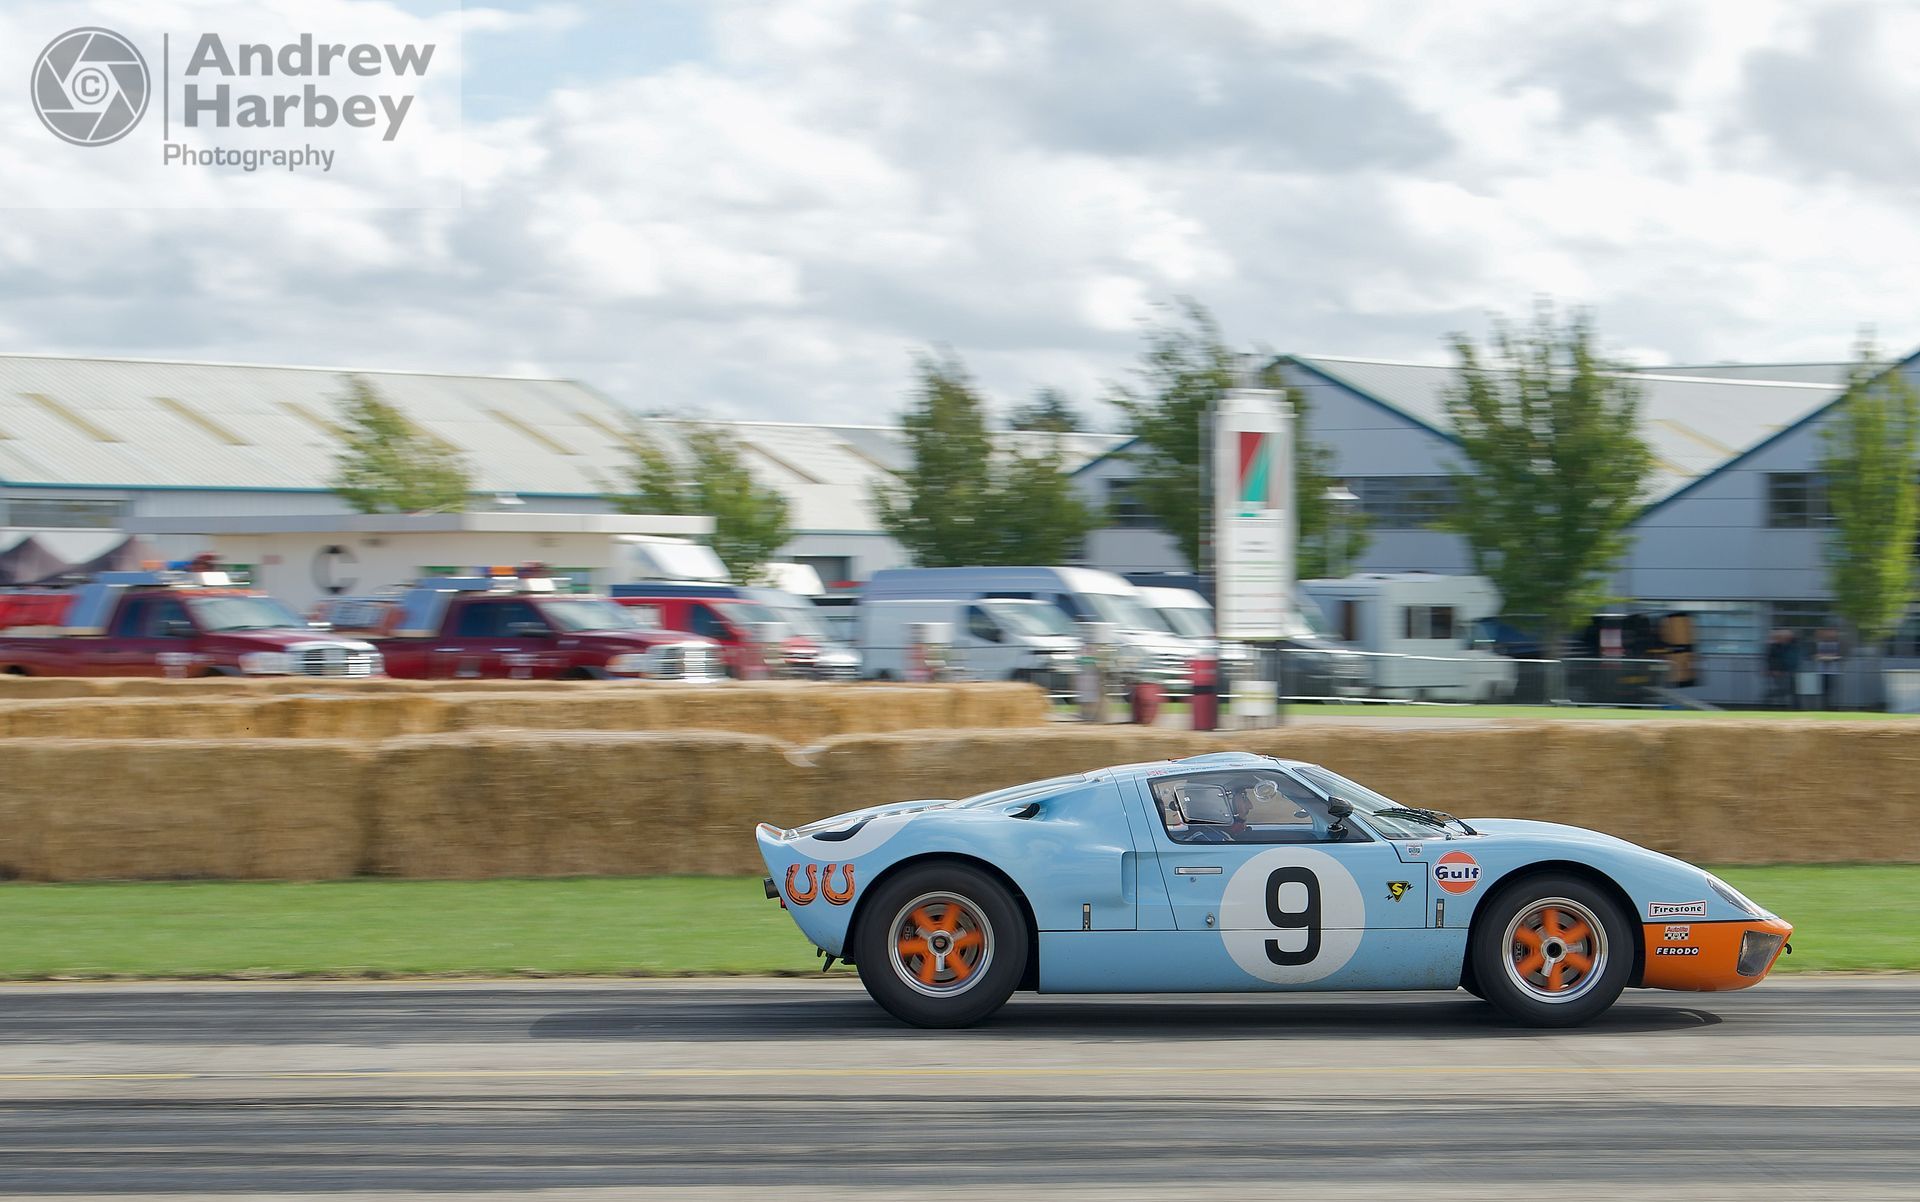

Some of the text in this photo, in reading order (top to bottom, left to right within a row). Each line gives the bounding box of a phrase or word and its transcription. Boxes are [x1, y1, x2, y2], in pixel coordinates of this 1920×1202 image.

[1435, 865, 1480, 880] Gulf
[1265, 866, 1322, 966] 9
[1653, 905, 1702, 915] Firestone
[1656, 947, 1699, 955] FERODO
